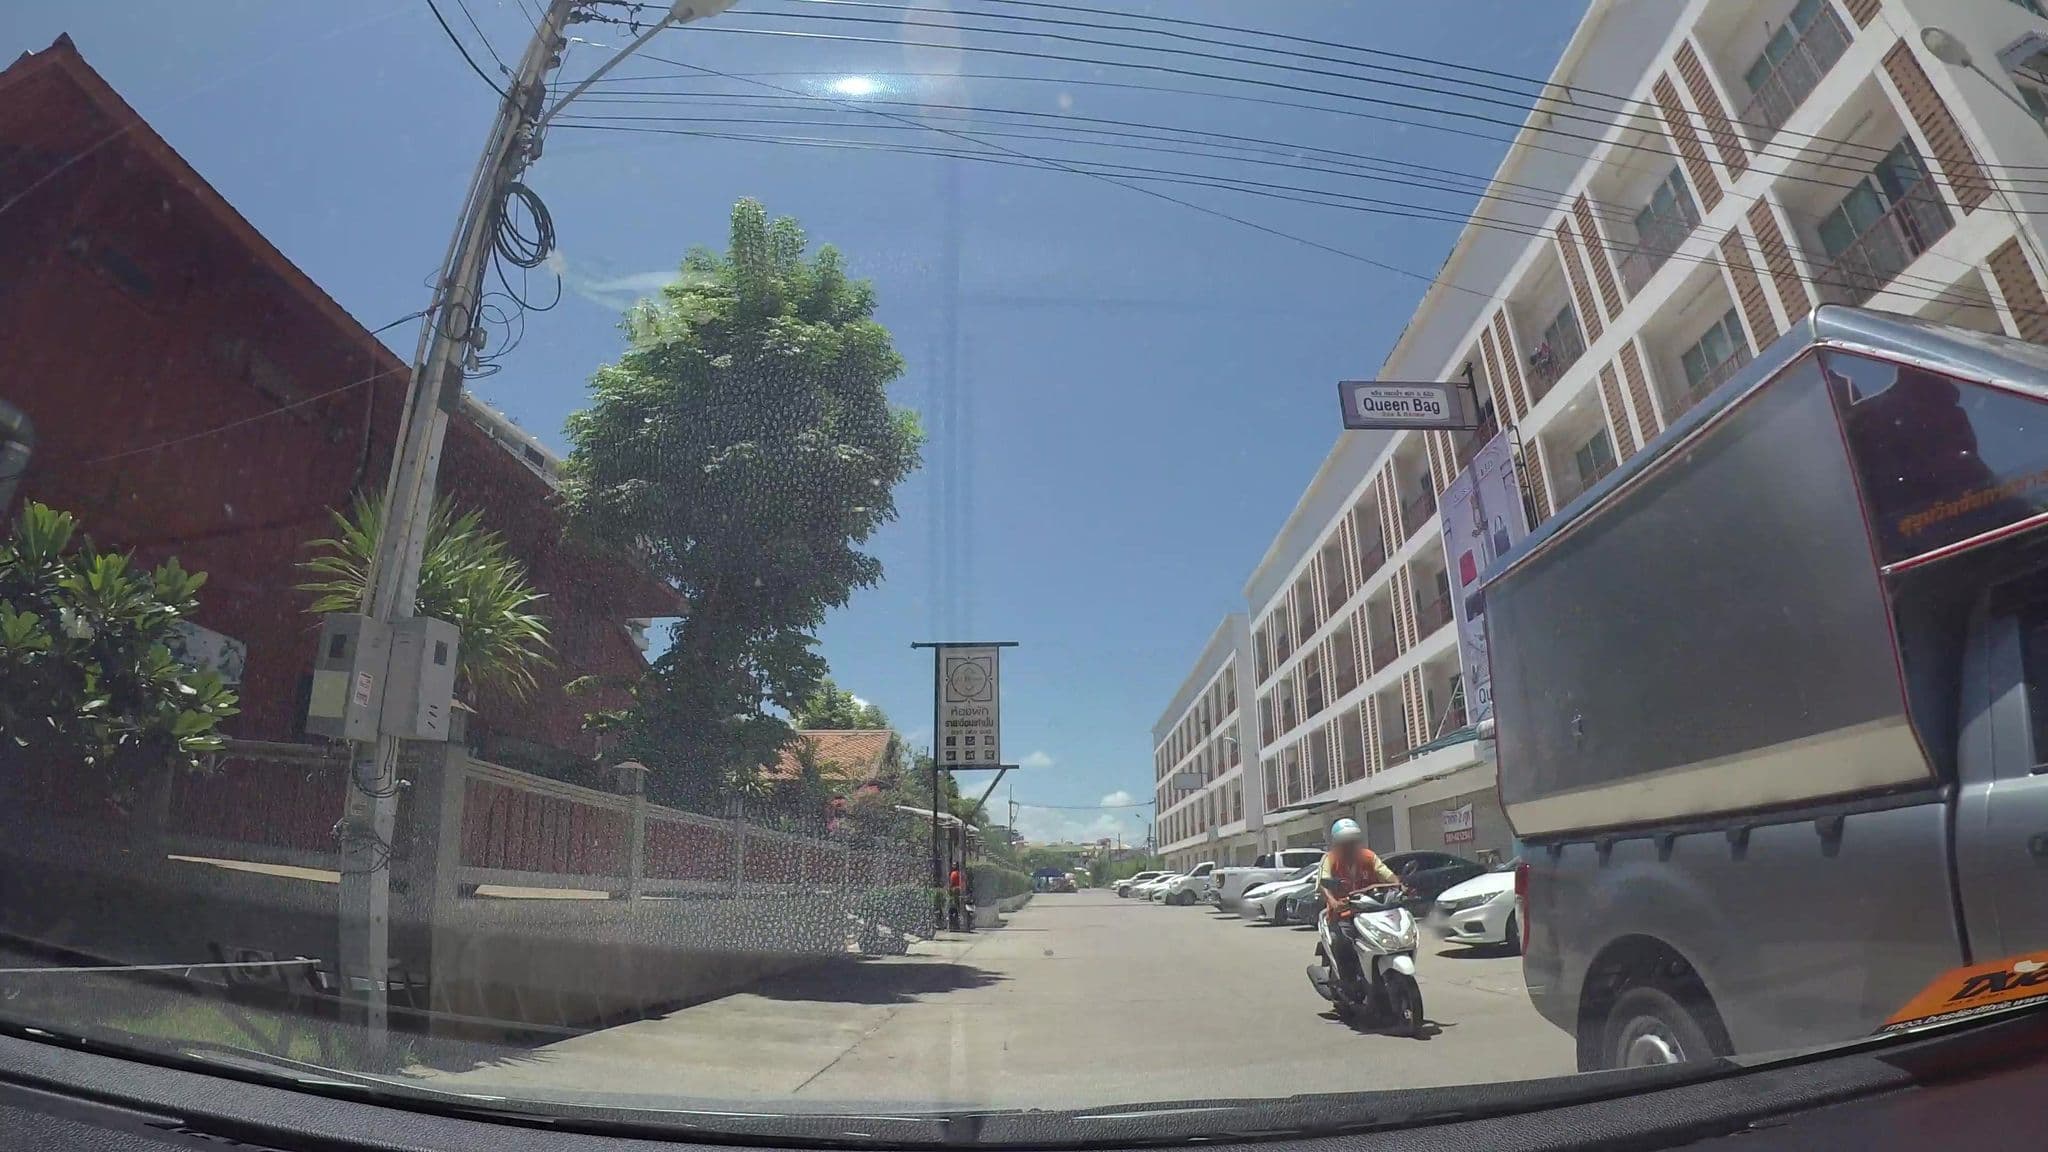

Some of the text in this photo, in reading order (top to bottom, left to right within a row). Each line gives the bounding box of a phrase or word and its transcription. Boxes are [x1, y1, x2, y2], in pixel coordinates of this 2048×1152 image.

[1363, 397, 1440, 414] Queen Bag
[951, 705, 989, 716] ห้องพัก
